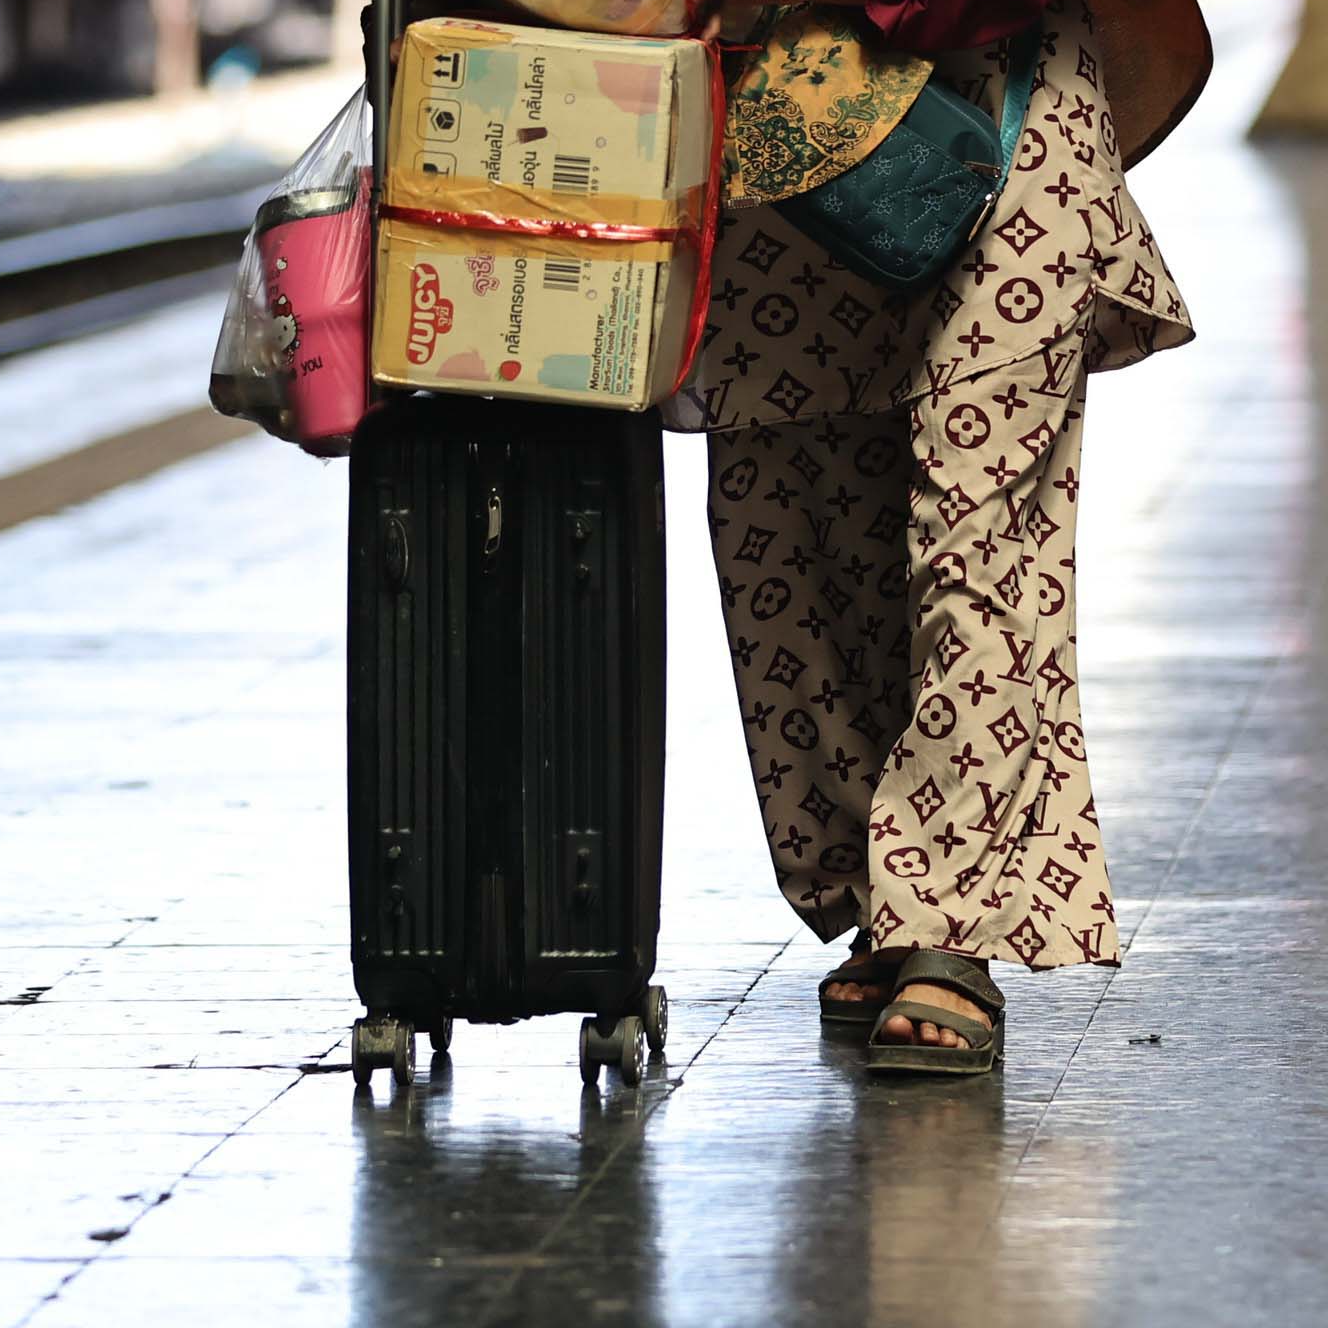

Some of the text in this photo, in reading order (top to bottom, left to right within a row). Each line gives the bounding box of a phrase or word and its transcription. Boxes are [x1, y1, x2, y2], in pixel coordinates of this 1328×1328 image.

[523, 56, 546, 121] กลิ่นโคล่า
[480, 120, 504, 181] ลลี่ผลไม้
[408, 266, 437, 362] JUICY
[609, 286, 621, 327] (Thailand)
[300, 355, 323, 376] you
[589, 314, 605, 391] Manufacturer
[606, 331, 616, 356] Foods
